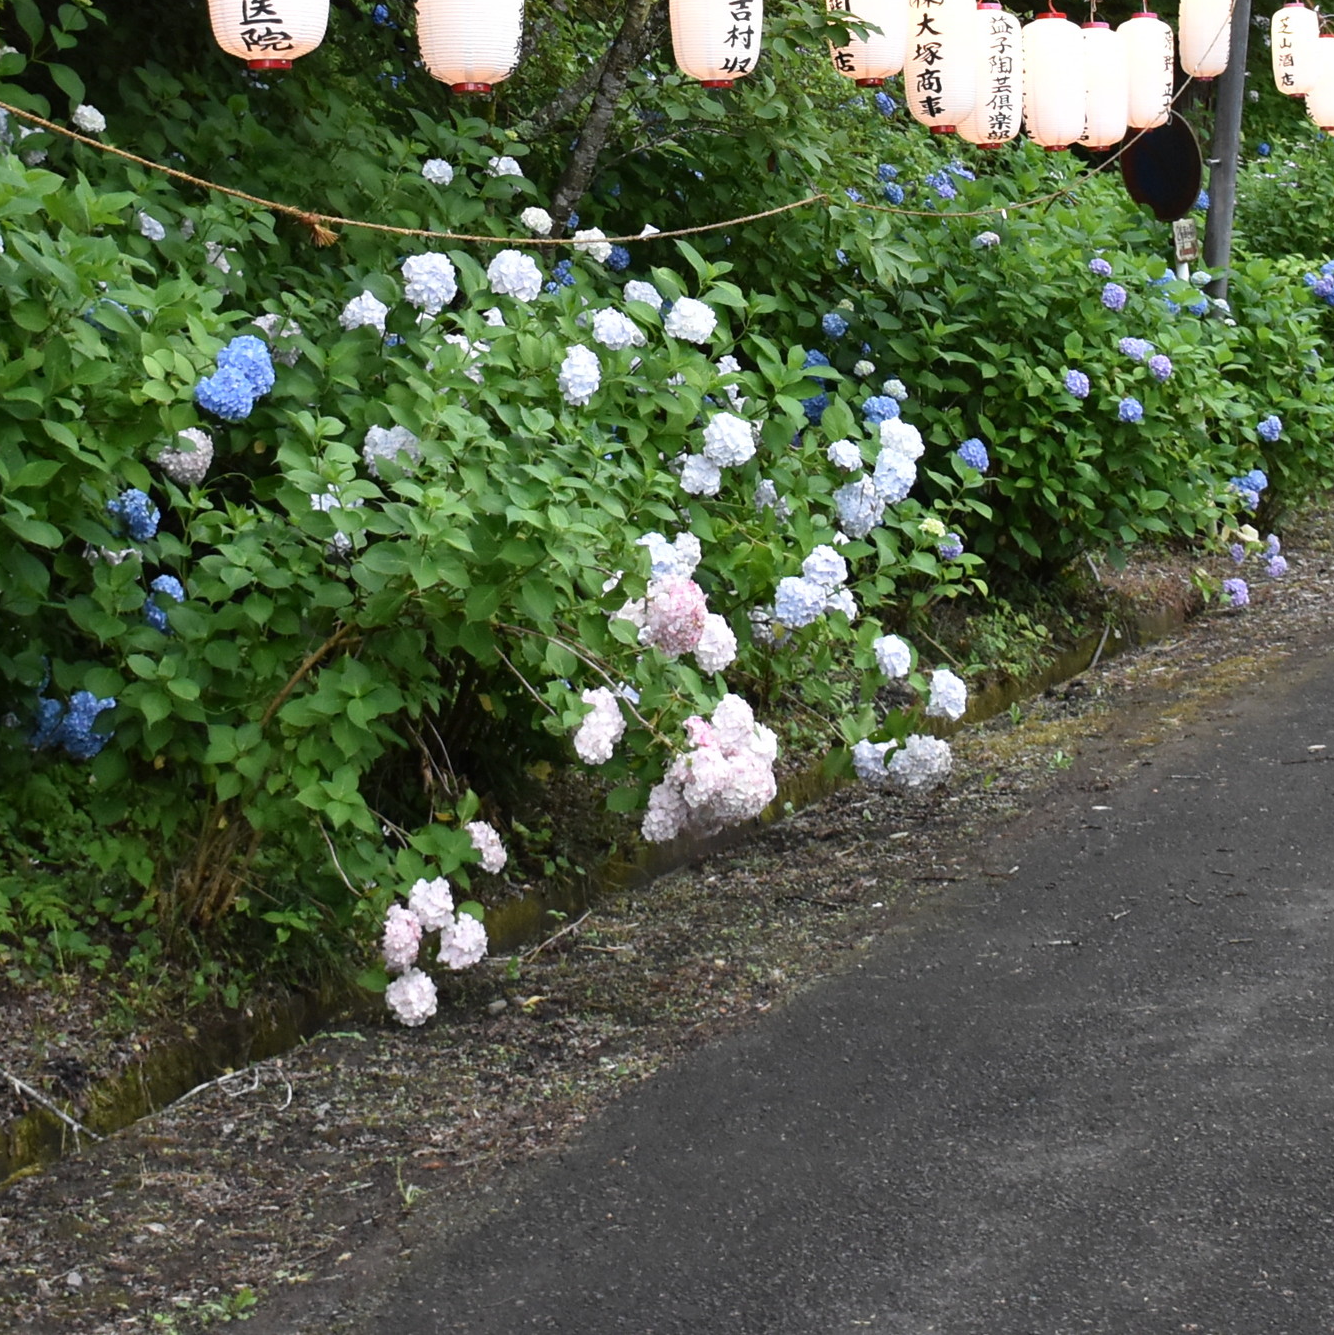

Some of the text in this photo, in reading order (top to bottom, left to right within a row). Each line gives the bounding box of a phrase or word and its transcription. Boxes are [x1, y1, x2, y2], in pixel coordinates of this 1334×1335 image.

[985, 16, 1013, 140] 益子陶芸倶楽部
[1278, 17, 1295, 87] 芝山酒店
